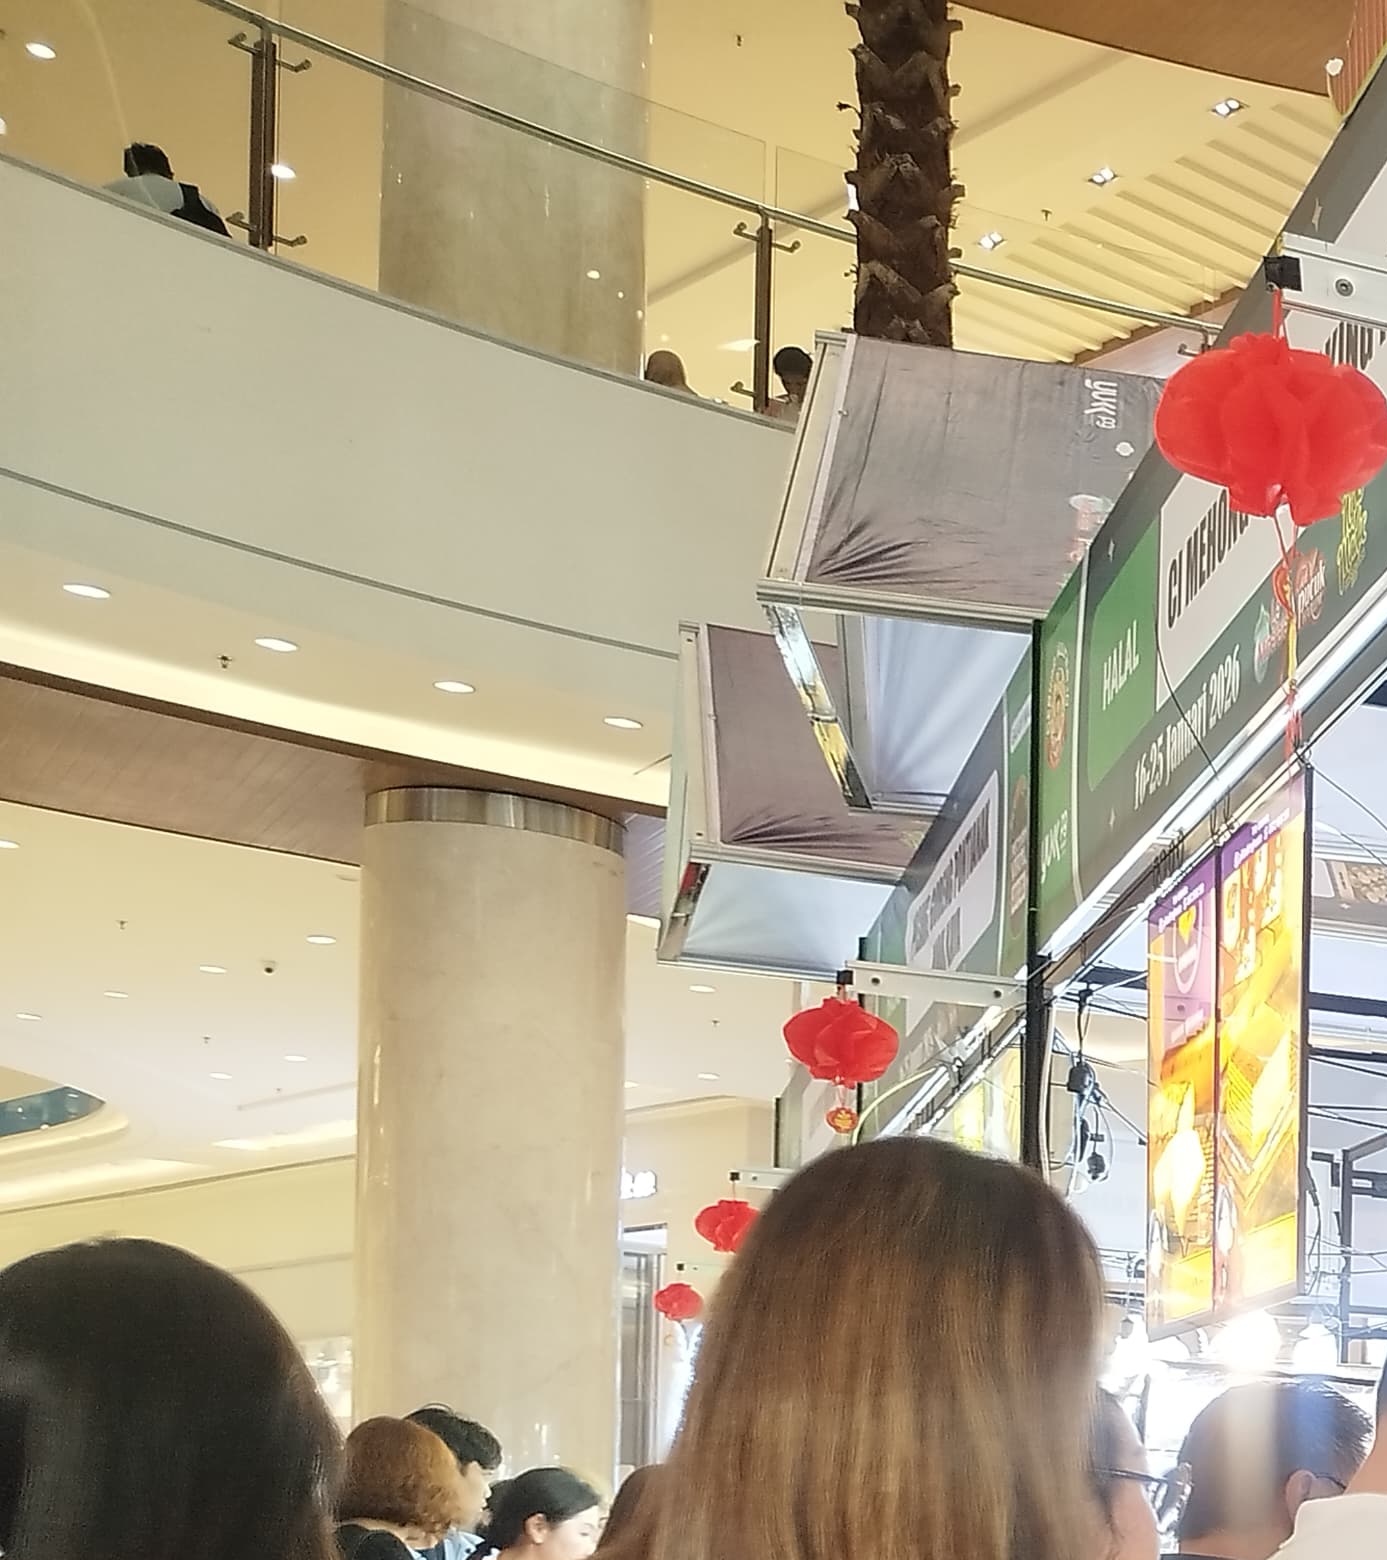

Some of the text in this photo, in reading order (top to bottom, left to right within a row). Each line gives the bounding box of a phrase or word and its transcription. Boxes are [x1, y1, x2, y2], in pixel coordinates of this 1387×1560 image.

[1167, 548, 1184, 629] CI
[1102, 618, 1140, 711] HALAL
[1133, 642, 1242, 811] 16-25 Januari 2026
